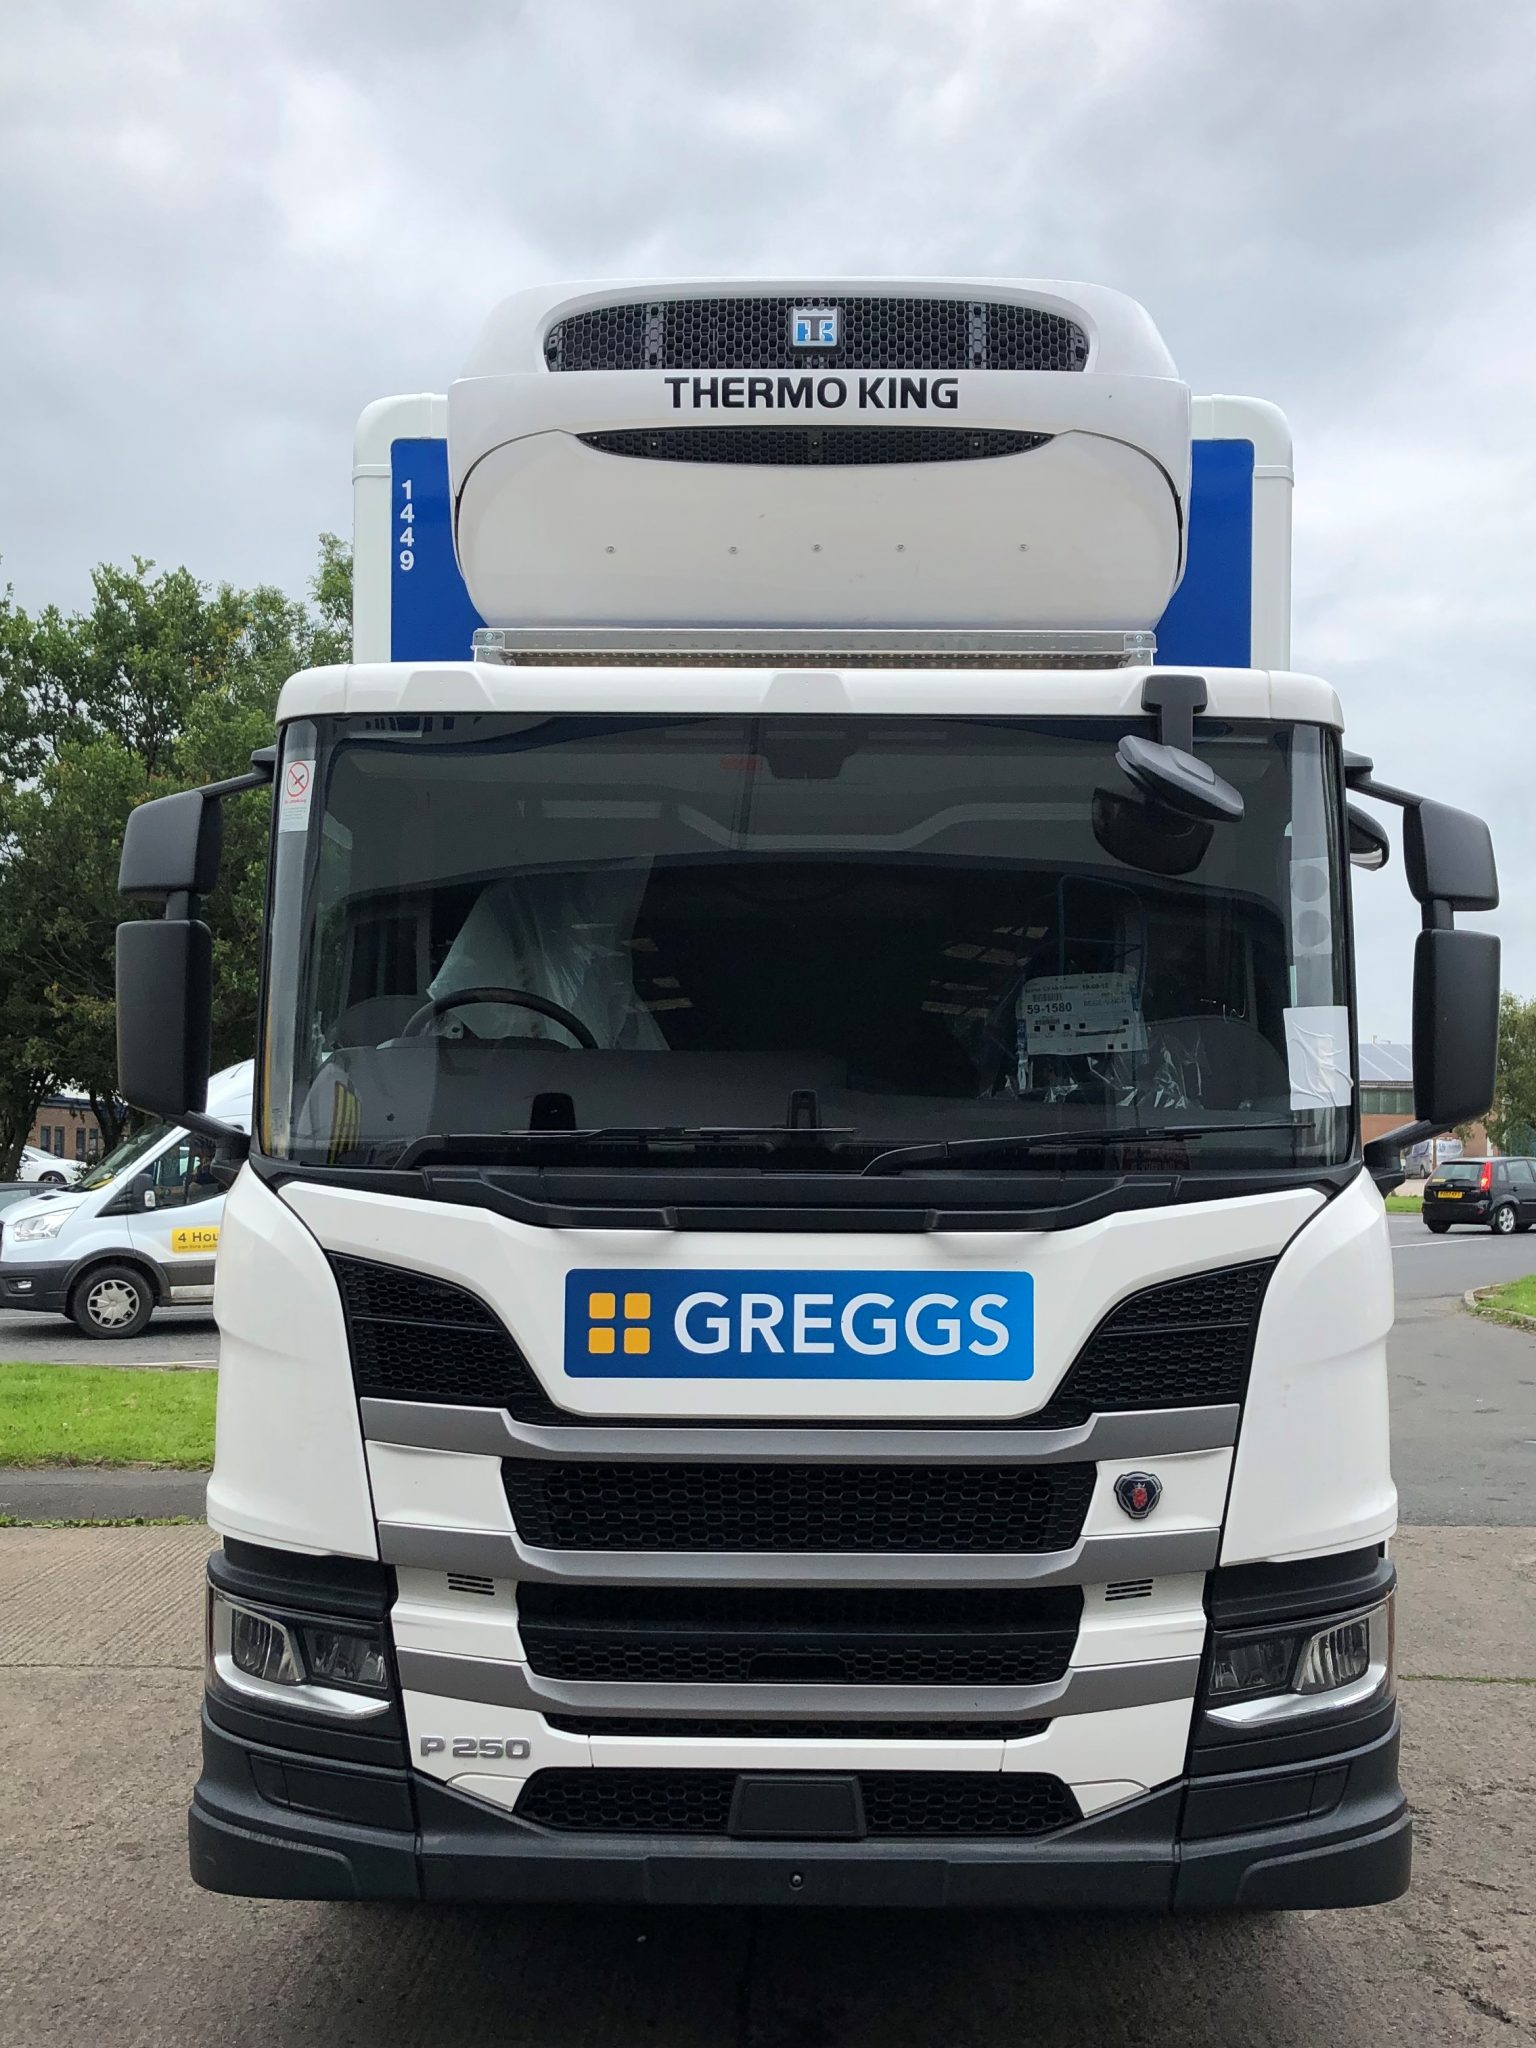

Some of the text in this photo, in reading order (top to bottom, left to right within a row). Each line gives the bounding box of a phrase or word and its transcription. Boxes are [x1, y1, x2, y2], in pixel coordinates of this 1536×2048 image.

[664, 376, 959, 410] THERMO KING
[399, 479, 415, 571] 1449
[1026, 1001, 1073, 1015] 59-1580
[177, 1232, 187, 1243] 4
[673, 1291, 1011, 1357] GREGGS
[420, 1735, 531, 1760] P 250
